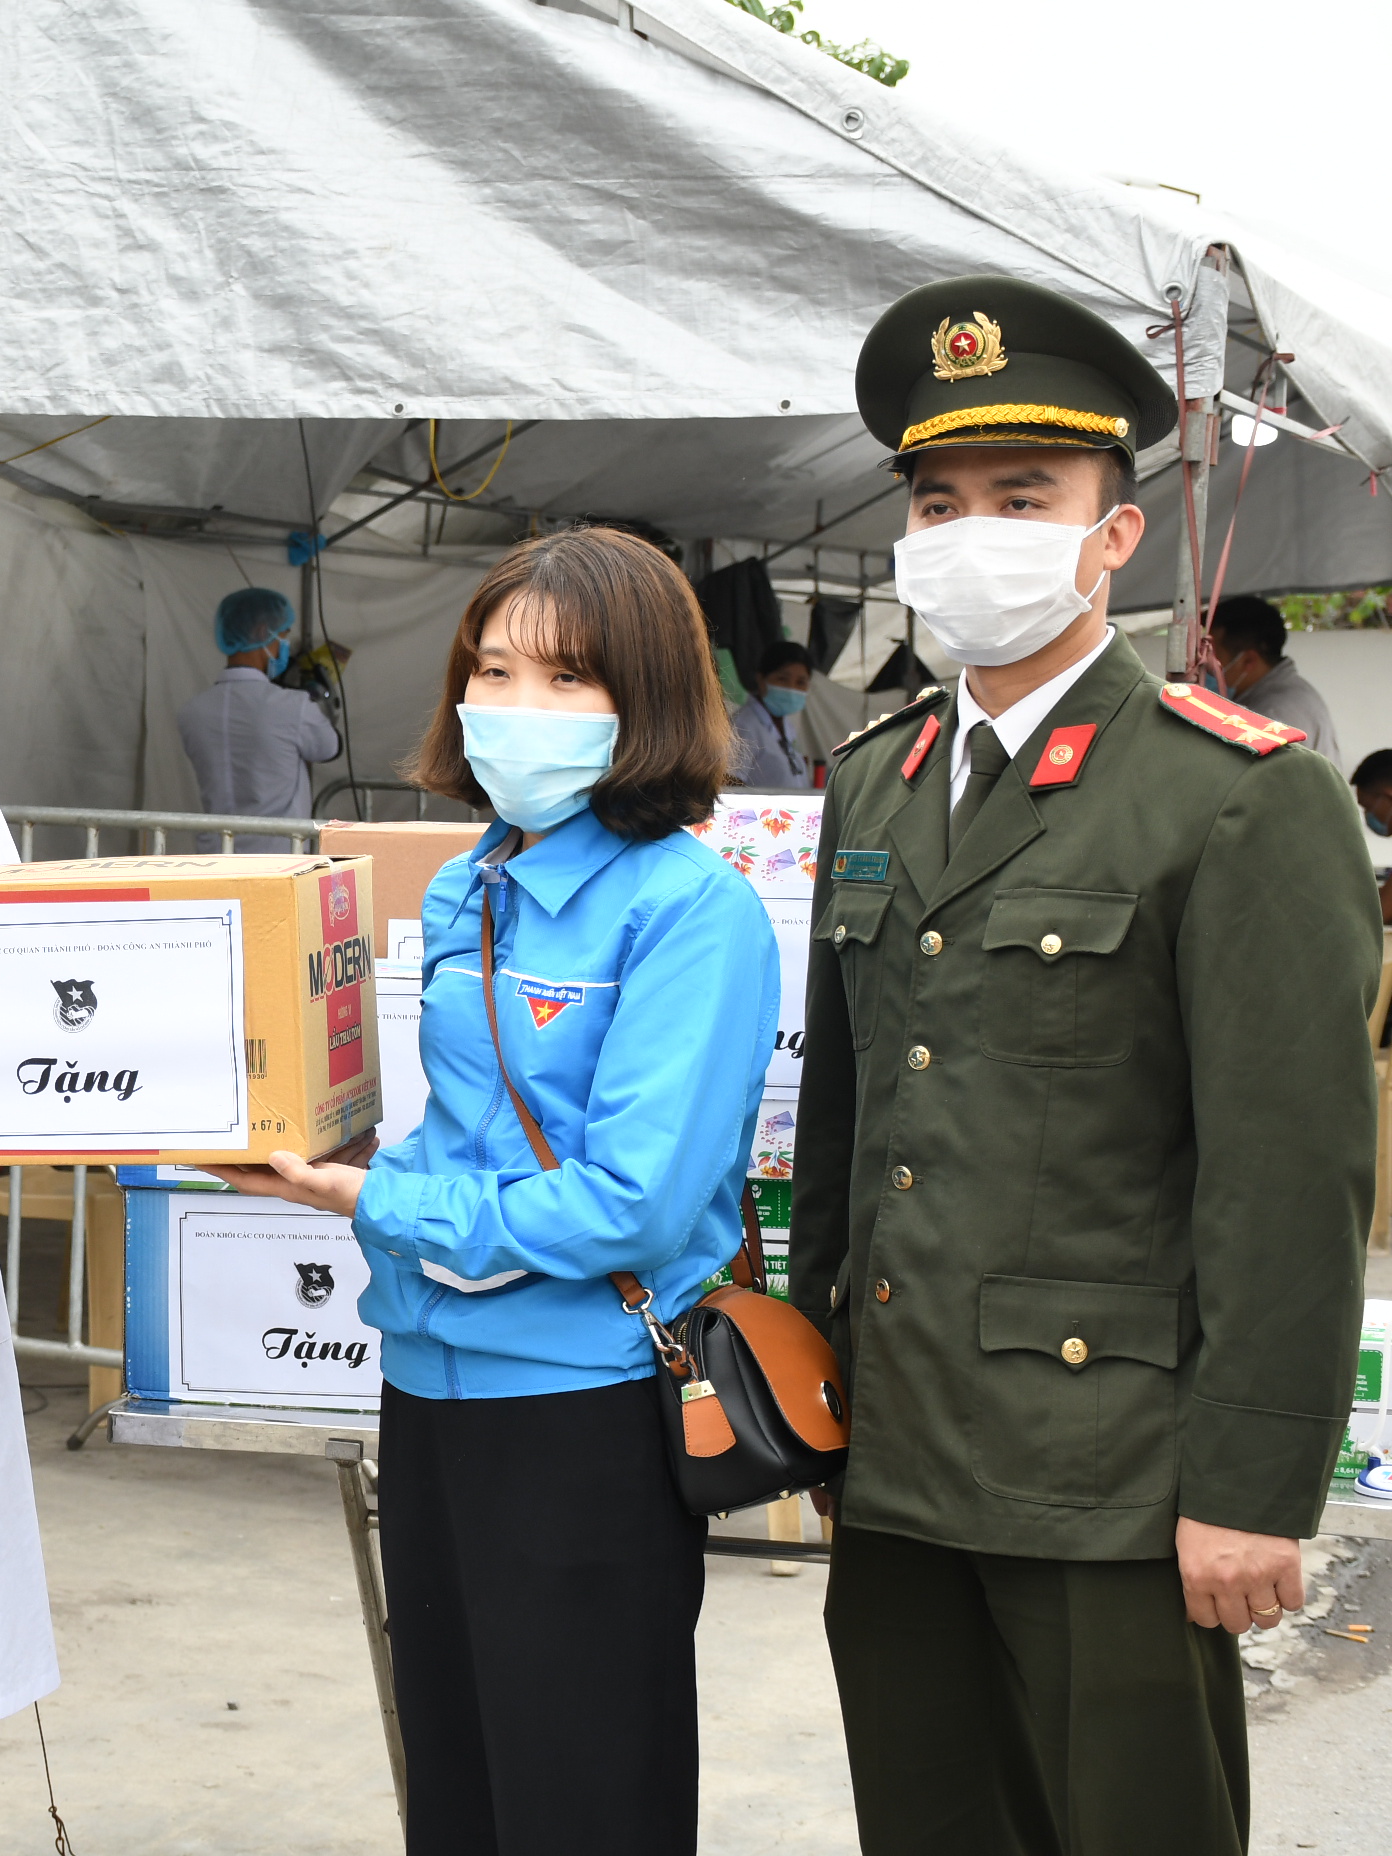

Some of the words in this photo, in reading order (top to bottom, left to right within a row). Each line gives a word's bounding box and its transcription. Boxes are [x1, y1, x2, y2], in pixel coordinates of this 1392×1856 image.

[16, 946, 40, 956] QUAN
[42, 944, 71, 954] THÀNH
[122, 941, 147, 951] CÔNG
[149, 942, 161, 950] AN
[162, 939, 192, 949] THÀNH
[308, 933, 371, 998] MODERN
[16, 1057, 143, 1104] Tặng
[260, 1119, 272, 1131] 67
[276, 1119, 286, 1134] g)
[195, 1230, 216, 1239] ĐOÀN
[265, 1233, 286, 1241] QUAN
[287, 1232, 313, 1241] THÀNH
[261, 1327, 371, 1369] Tặng
